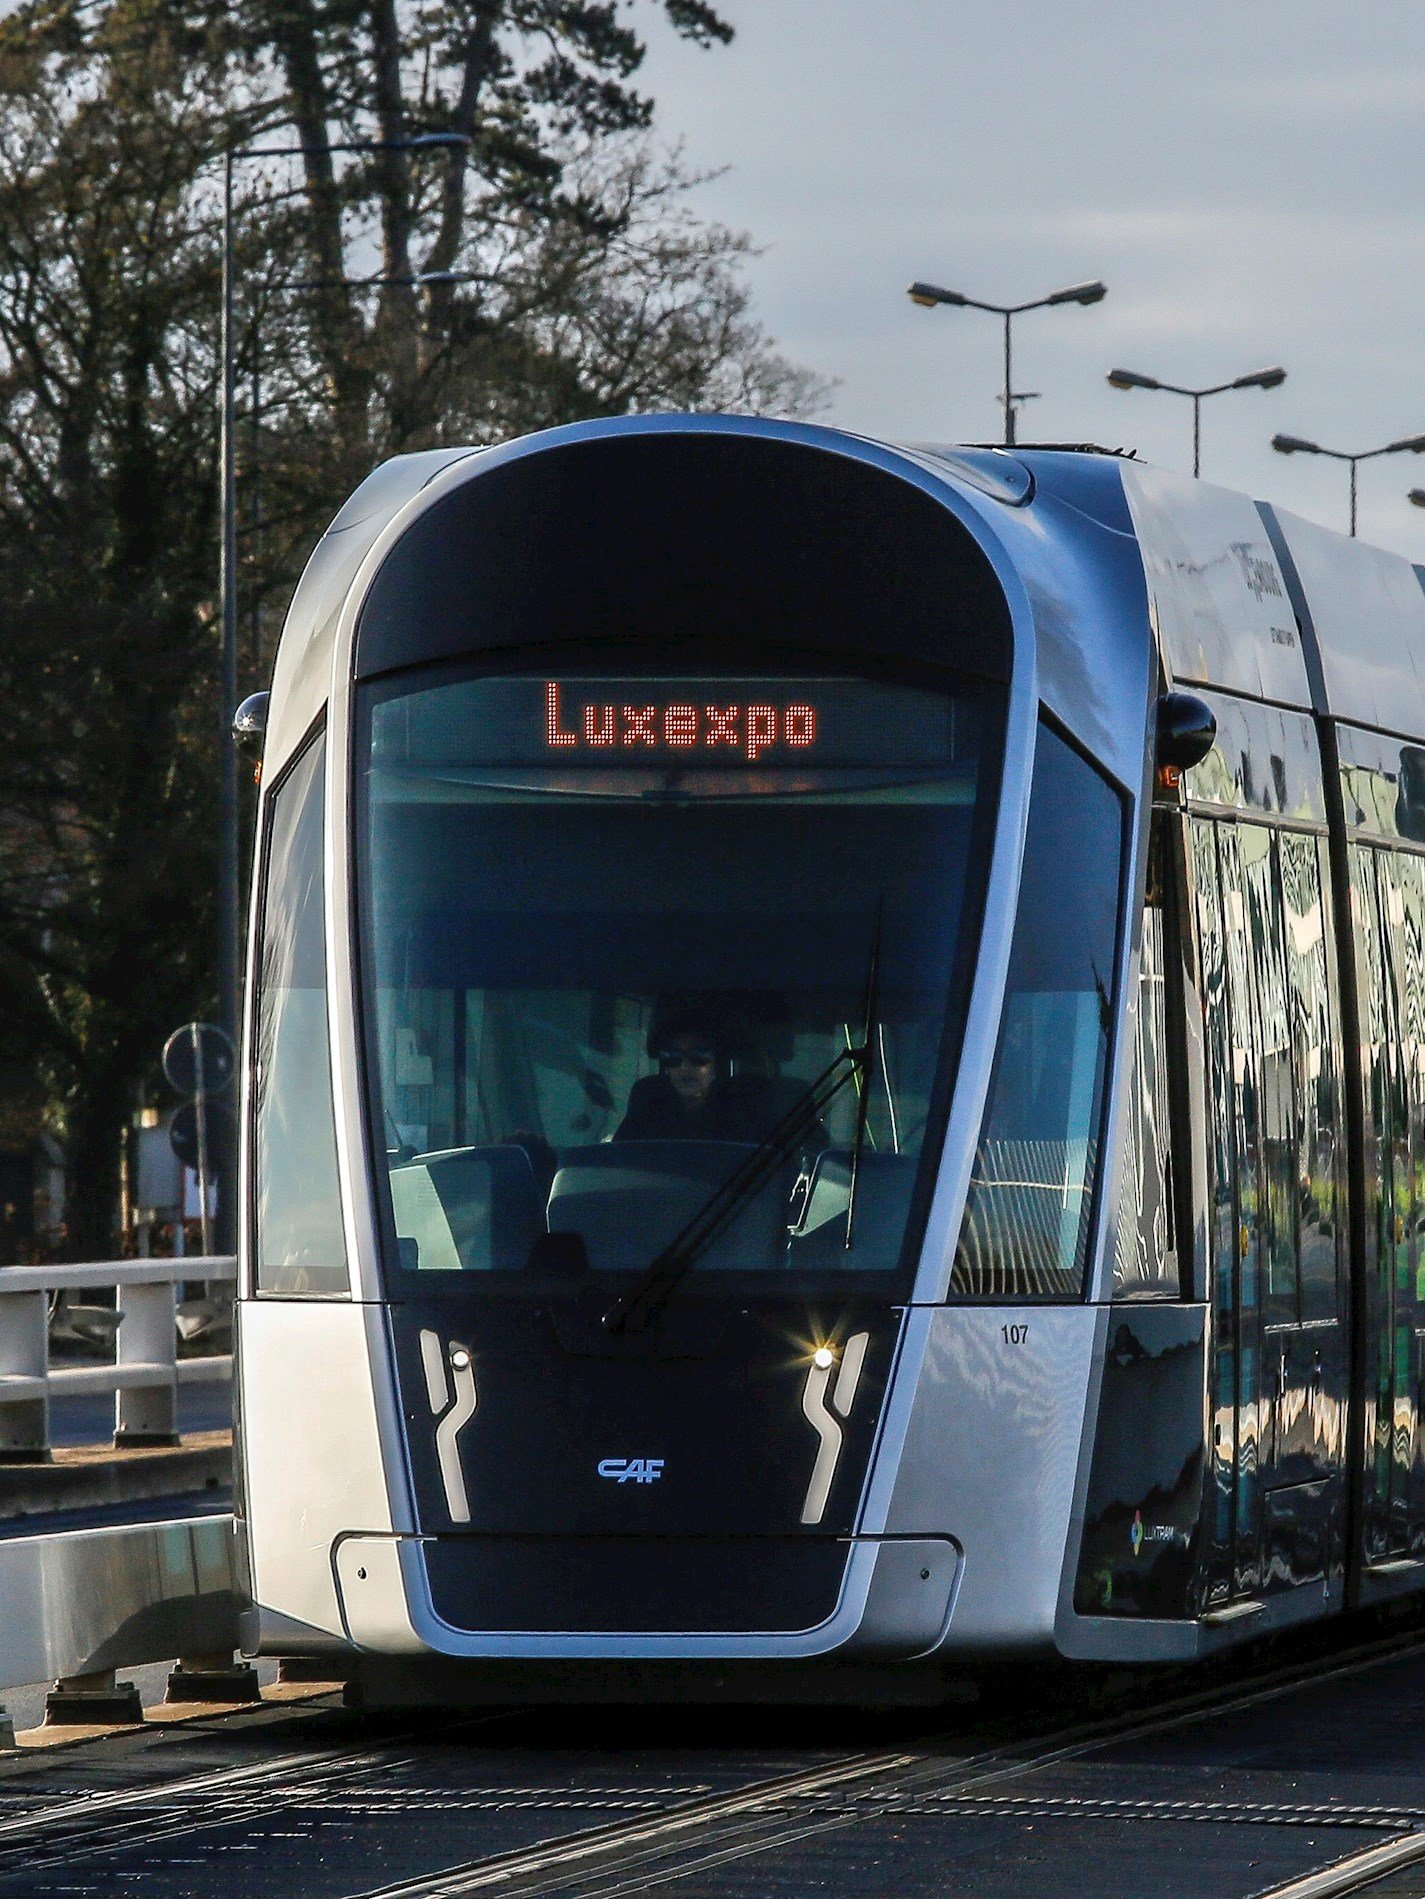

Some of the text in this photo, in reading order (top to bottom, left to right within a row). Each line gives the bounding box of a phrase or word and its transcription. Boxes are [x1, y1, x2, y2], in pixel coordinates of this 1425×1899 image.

[545, 681, 816, 760] Luxexpo
[1001, 1324, 1028, 1344] 107
[598, 1459, 664, 1483] CAF
[1144, 1525, 1174, 1541] LUXTRAM
